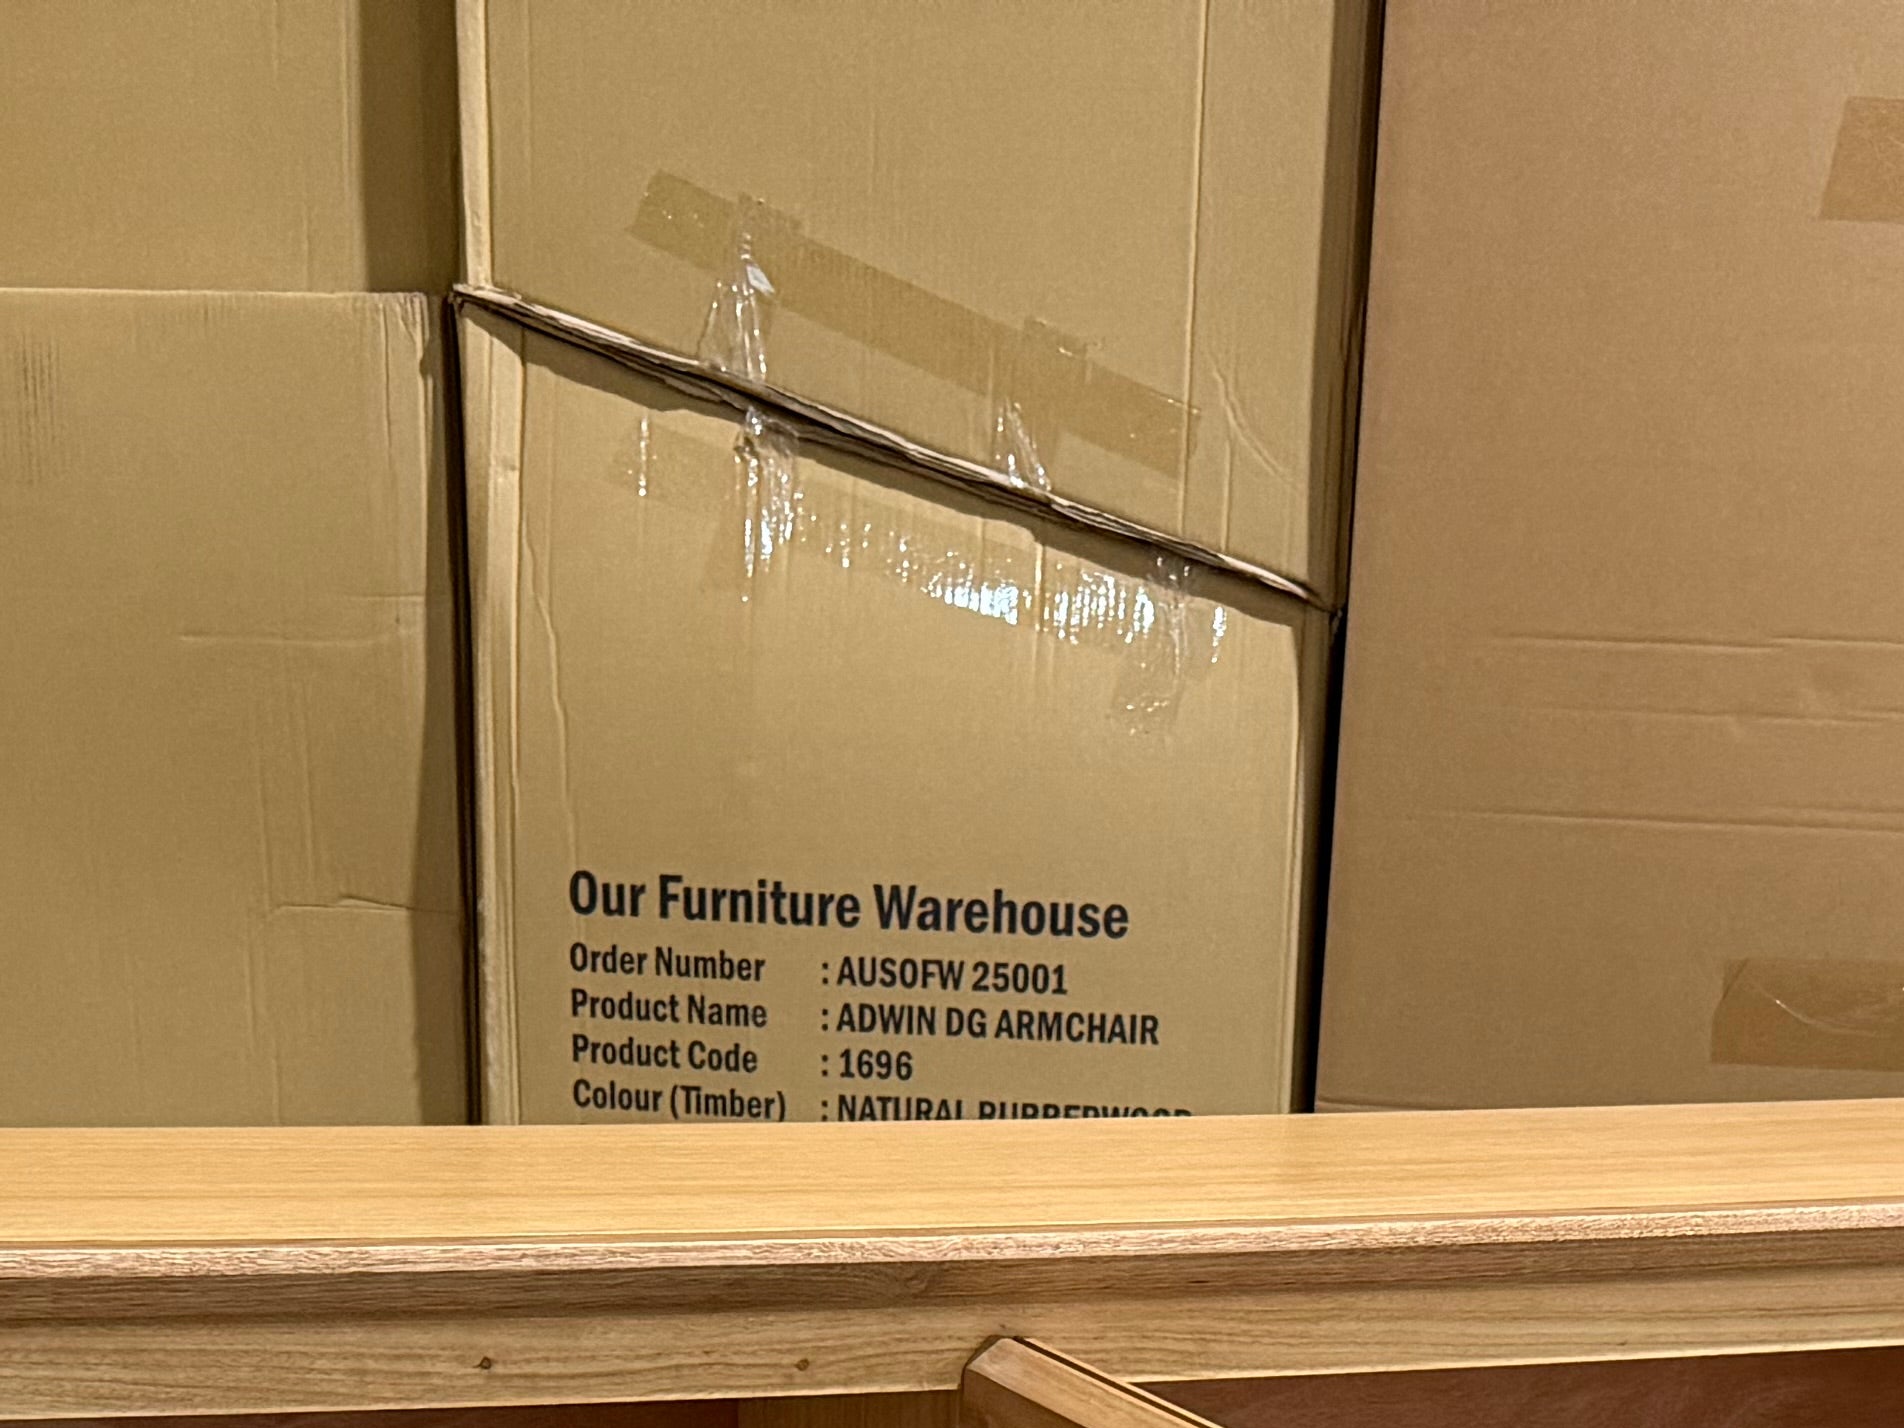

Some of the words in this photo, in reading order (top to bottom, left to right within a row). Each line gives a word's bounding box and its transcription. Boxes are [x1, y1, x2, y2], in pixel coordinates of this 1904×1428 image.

[569, 870, 646, 917] Our
[659, 874, 860, 928] Furniture
[873, 884, 1128, 939] Warehouse
[570, 942, 648, 975] Order
[655, 946, 765, 981] Number
[837, 956, 964, 991] AUSOFW
[972, 961, 1067, 995] 25001
[571, 988, 680, 1023] Product
[688, 994, 767, 1028] Name
[836, 1003, 936, 1035] ADWIN
[946, 1007, 986, 1038] DG
[994, 1009, 1158, 1045] ARMCHAIR
[572, 1034, 680, 1069] Product
[688, 1040, 757, 1073] Code
[840, 1048, 912, 1081] 1696
[573, 1078, 663, 1112] Colour
[670, 1085, 785, 1122] (Timber)
